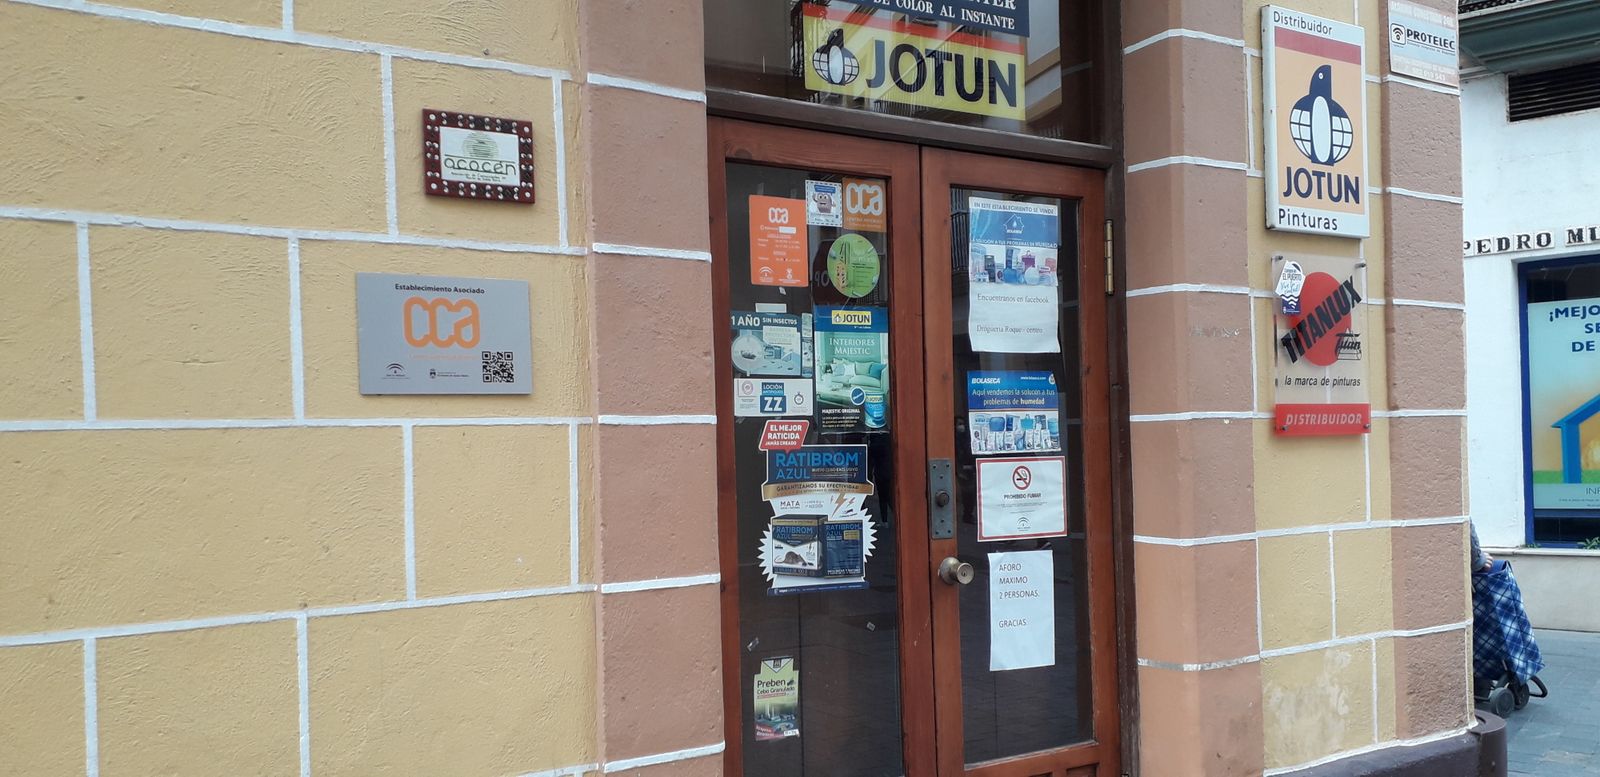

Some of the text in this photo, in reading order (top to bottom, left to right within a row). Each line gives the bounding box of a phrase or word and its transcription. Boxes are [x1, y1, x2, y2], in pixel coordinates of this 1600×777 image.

[896, 0, 934, 14] COLOR
[940, 4, 956, 18] AL
[961, 8, 1015, 30] INSTANTE
[1273, 11, 1332, 36] Distribuidor
[1406, 28, 1455, 50] PROTELEC
[866, 40, 1016, 108] JOTUN
[1283, 166, 1360, 204] JOTUN
[992, 204, 1032, 212] ESTABLECIMIENTO
[1278, 208, 1338, 231] Pinturas
[395, 284, 452, 293] Establecimiento
[731, 316, 736, 325] 1
[738, 314, 760, 326] AÑO
[842, 315, 870, 323] JOTUN
[1281, 275, 1362, 364] TITANLUX
[830, 338, 875, 346] INTERIORES
[1572, 340, 1595, 352] DE
[835, 346, 870, 355] MAJESTIC
[1285, 375, 1360, 388] la marca de pinturas
[764, 397, 783, 412] ZZ
[984, 397, 1012, 406] problemas
[1286, 413, 1362, 425] DISTRIBUIDOR
[776, 452, 858, 467] RATIBROM
[776, 468, 810, 480] AZUL
[1000, 576, 1028, 584] MAXIMO
[999, 619, 1027, 628] GRACIAS
[757, 679, 786, 688] Preben
